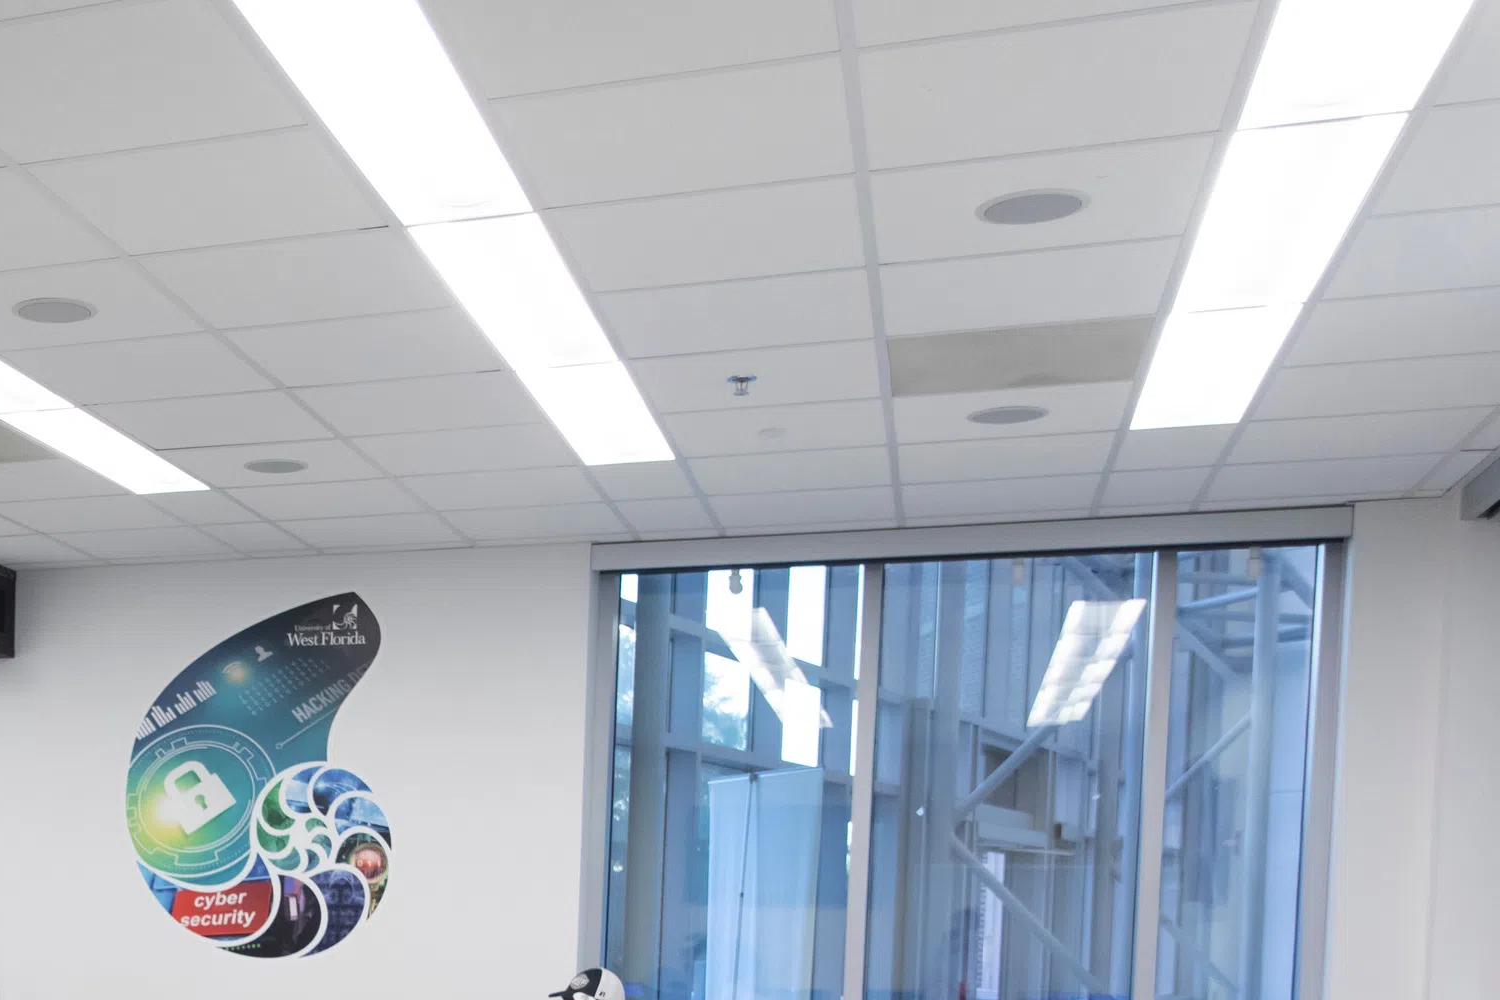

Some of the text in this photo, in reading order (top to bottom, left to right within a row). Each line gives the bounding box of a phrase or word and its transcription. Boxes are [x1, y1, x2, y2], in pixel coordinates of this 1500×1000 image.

[286, 631, 366, 646] West Florida
[291, 679, 351, 724] HACKING
[194, 891, 247, 911] cyber
[181, 909, 256, 928] security
